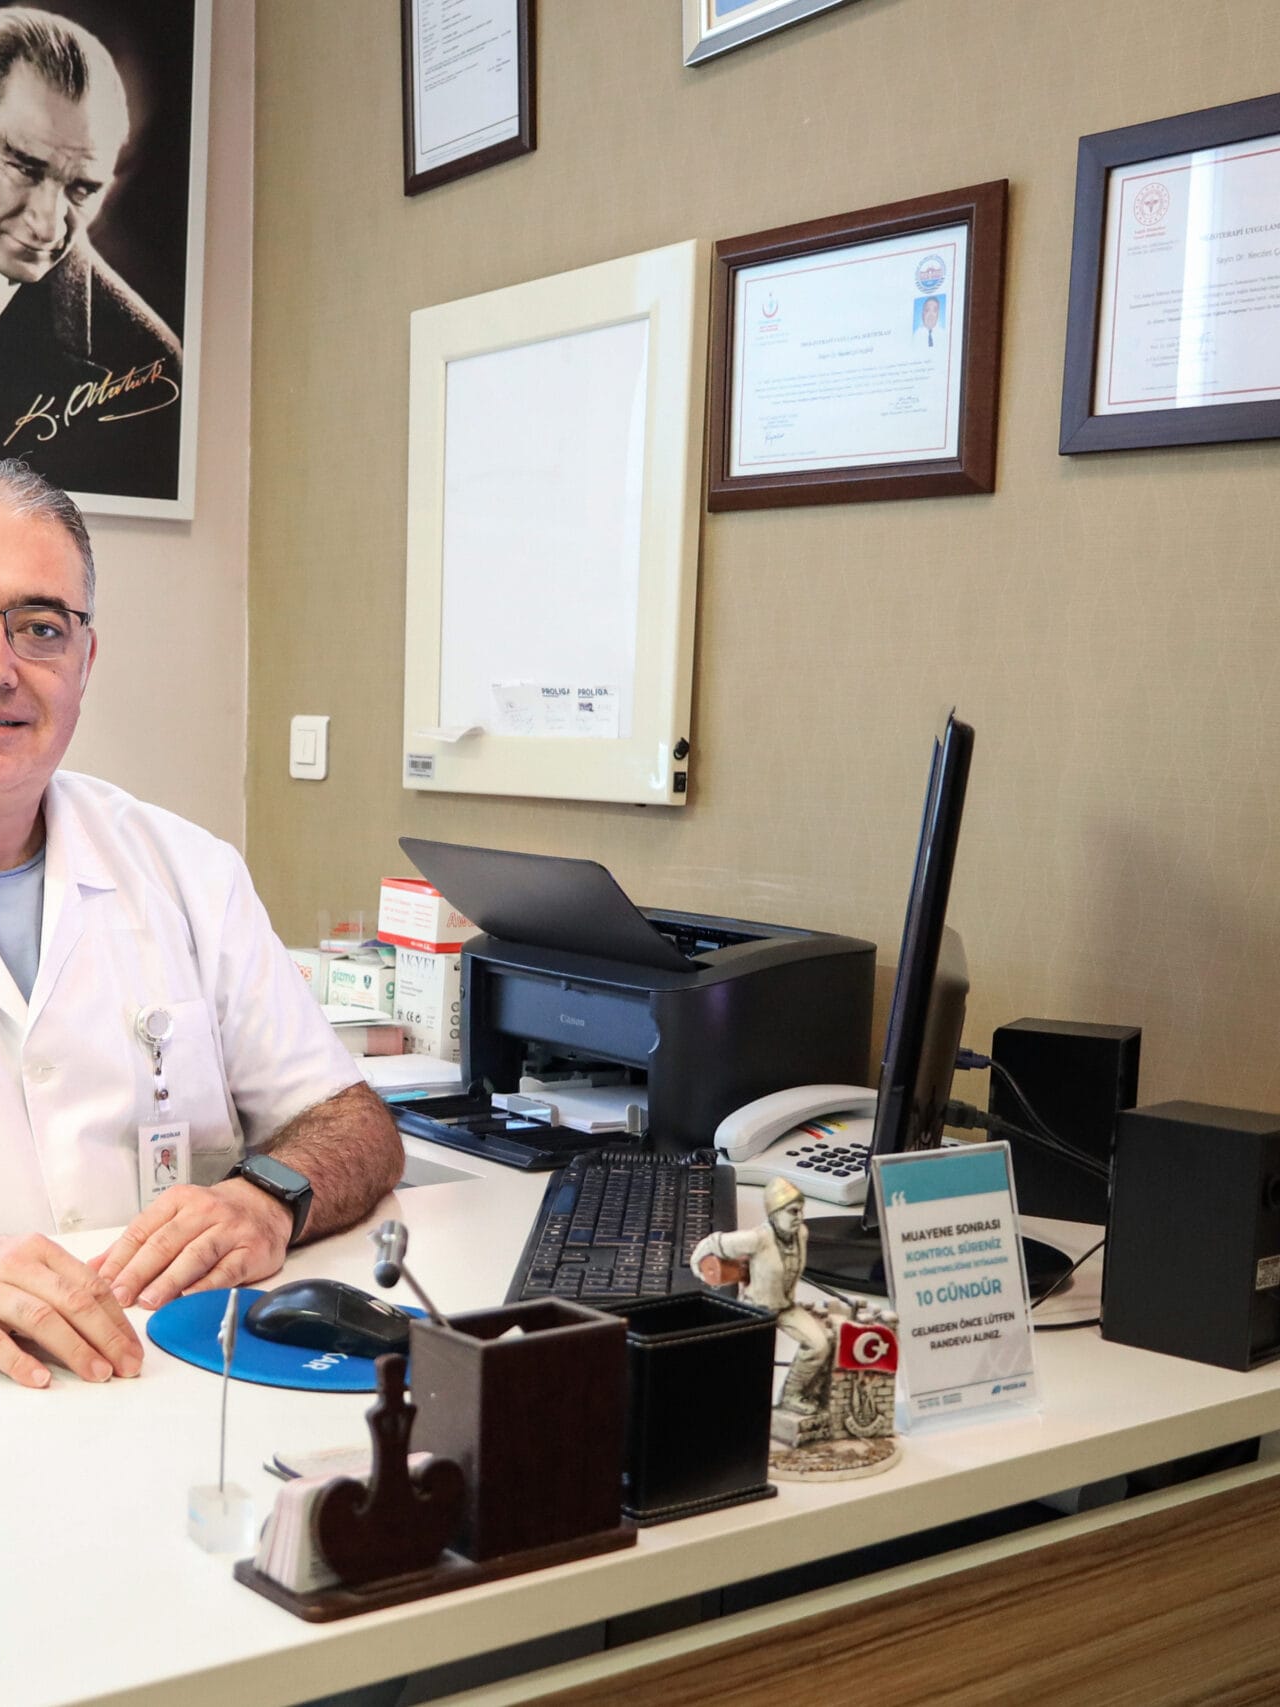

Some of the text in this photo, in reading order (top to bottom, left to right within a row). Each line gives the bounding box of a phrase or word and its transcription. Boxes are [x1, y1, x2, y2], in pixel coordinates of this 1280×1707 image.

[559, 1013, 585, 1027] Canon
[901, 1219, 1001, 1243] MUAYENE SONRASI
[906, 1247, 956, 1262] KONTROL
[916, 1276, 1002, 1307] 10 GÜNDÜR
[911, 1311, 1016, 1338] GELMEDEN ÖNCE LÜTFEN
[930, 1336, 972, 1350] RANDEVU
